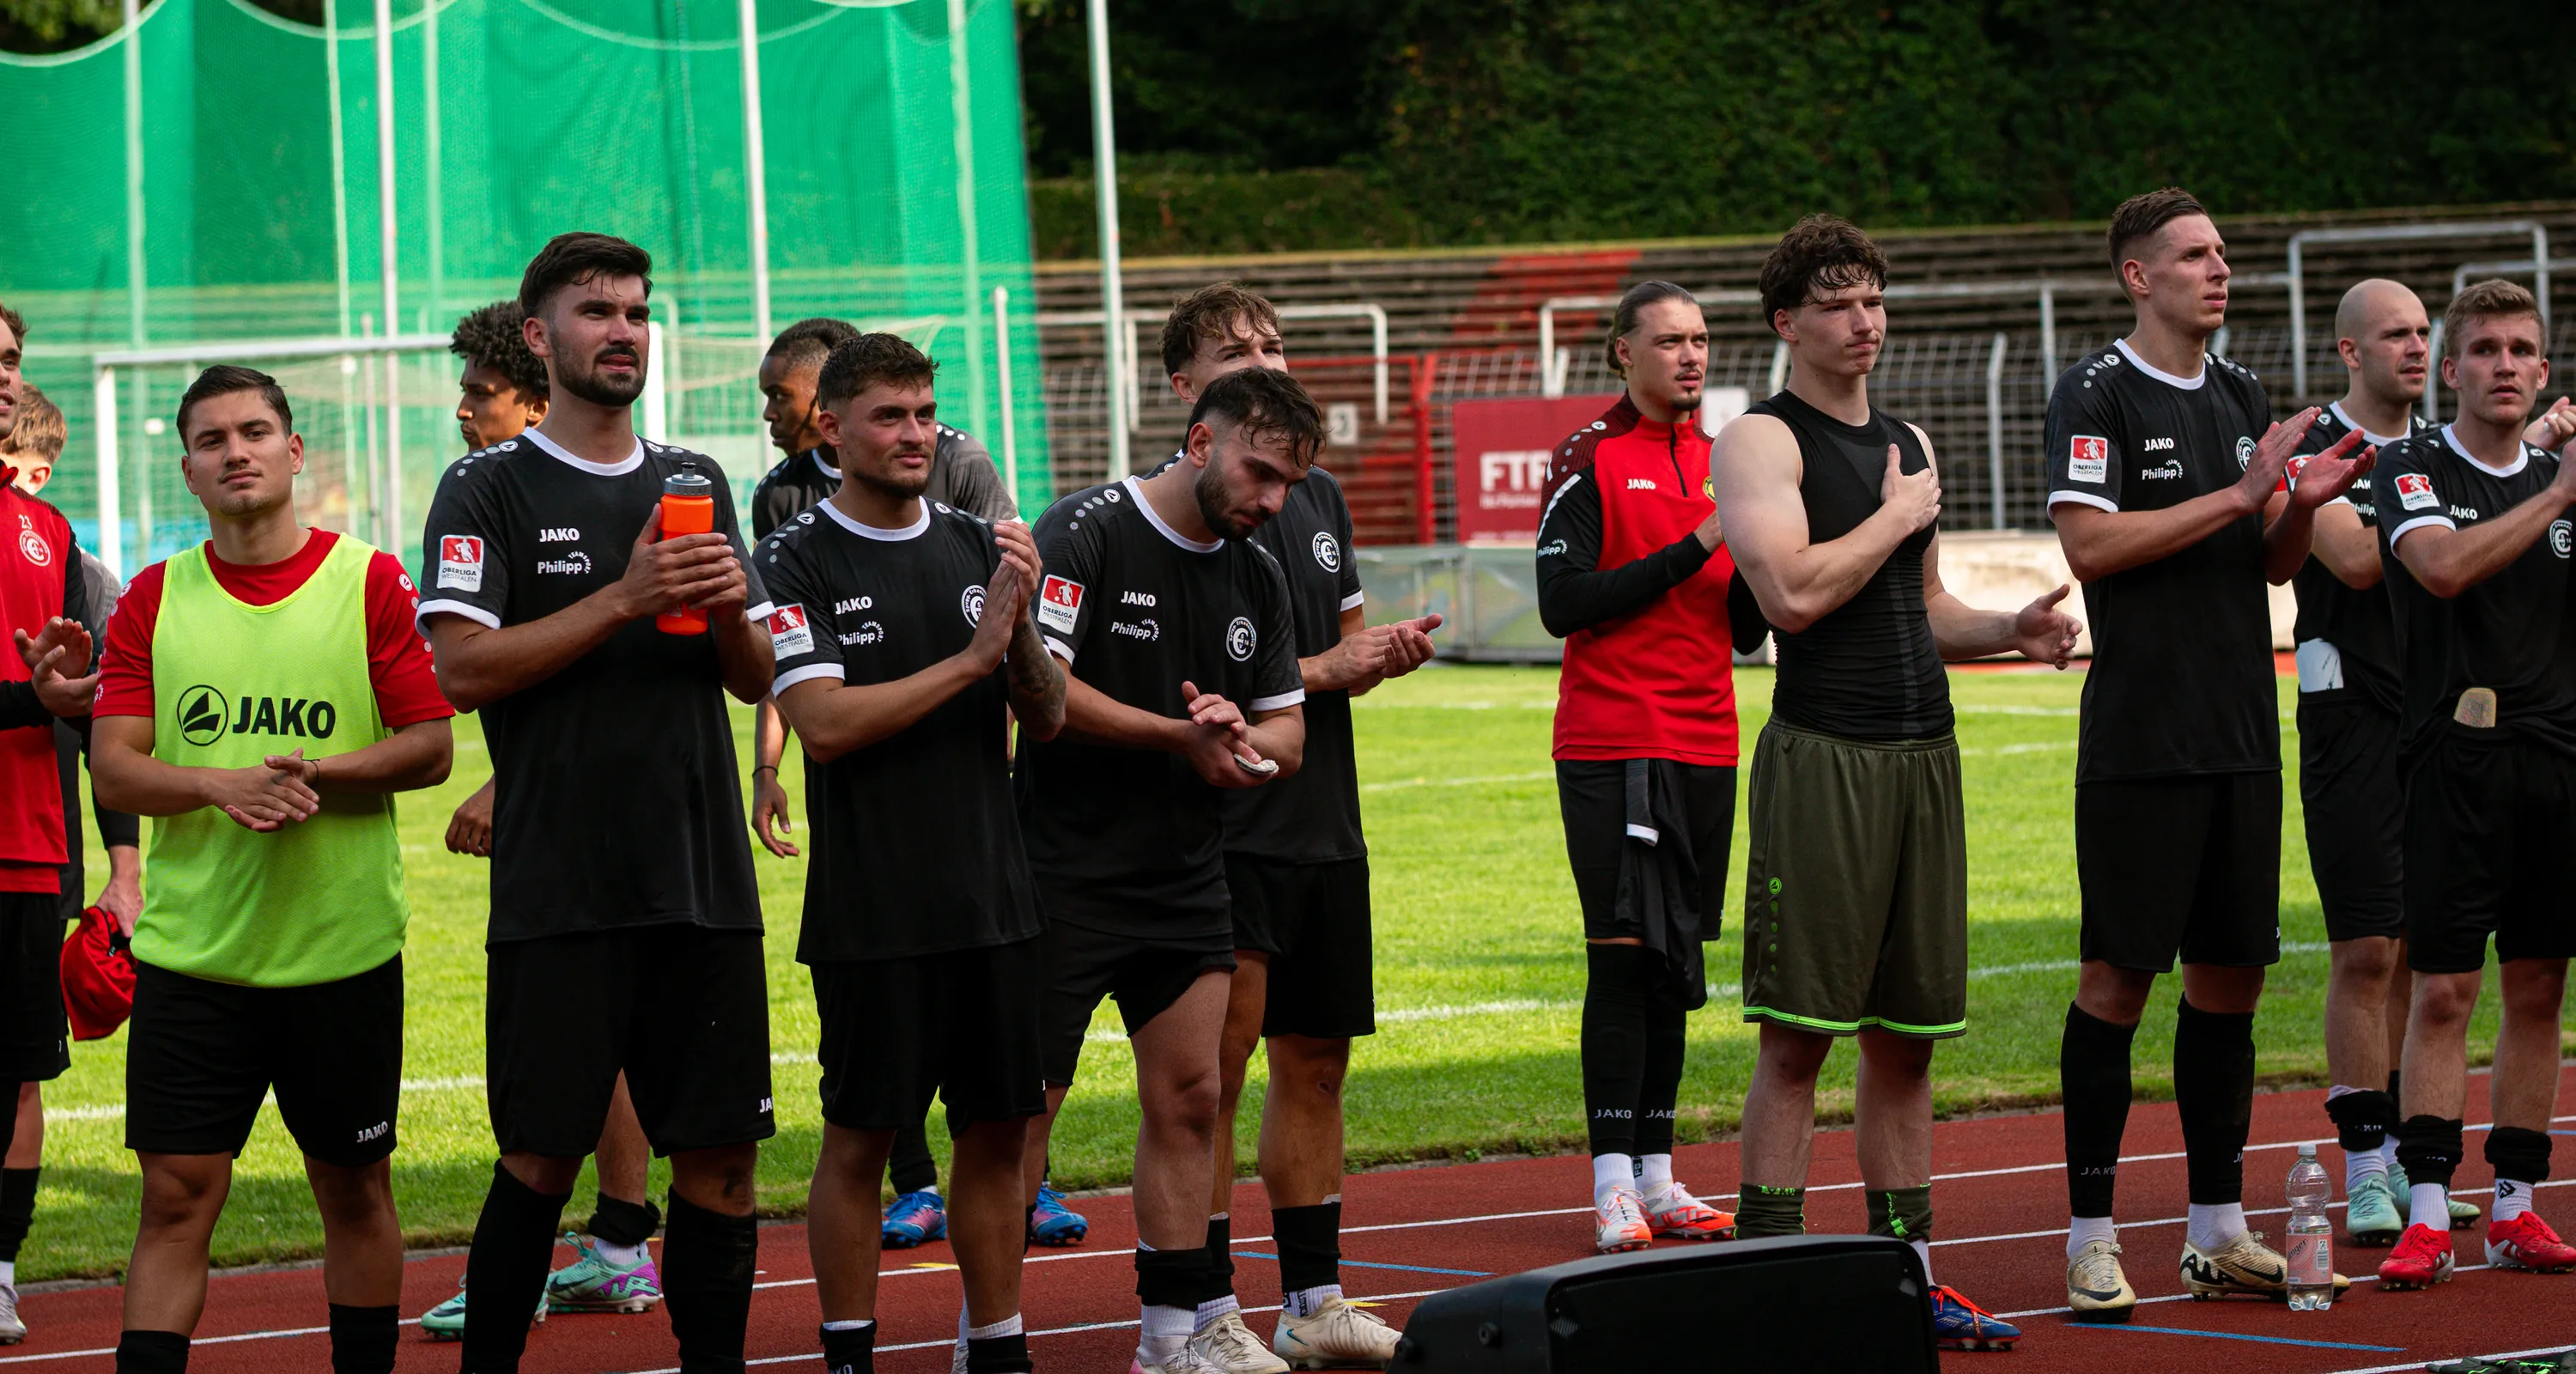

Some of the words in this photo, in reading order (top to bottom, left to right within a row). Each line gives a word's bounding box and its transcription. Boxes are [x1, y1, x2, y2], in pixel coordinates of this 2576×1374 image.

[2144, 437, 2174, 452] JAKO
[2142, 467, 2177, 480] Philipp
[1627, 478, 1656, 490] JAKO
[2449, 505, 2478, 520] JAKO
[18, 514, 33, 530] 23
[539, 527, 580, 543] JAKO
[538, 560, 583, 575] Philipp
[568, 550, 592, 575] TEAMSPORT
[440, 574, 477, 583] WESTFALEN
[441, 567, 477, 577] OBERLIGA
[835, 596, 872, 615] JAKO
[1121, 591, 1157, 607] JAKO
[1042, 605, 1072, 619] OBERLIGA
[861, 621, 884, 643] TEAMSPORT
[1111, 621, 1151, 641] Philipp
[1141, 618, 1160, 641] TEAMSPORT
[775, 633, 807, 646] OBERLIGA
[775, 638, 809, 651] WESTFALEN
[232, 696, 336, 739] JAKO
[1595, 1109, 1631, 1119] JAKO
[1645, 1109, 1677, 1119] JAKO
[356, 1121, 388, 1143] JAKO
[2081, 1165, 2116, 1176] JAKO
